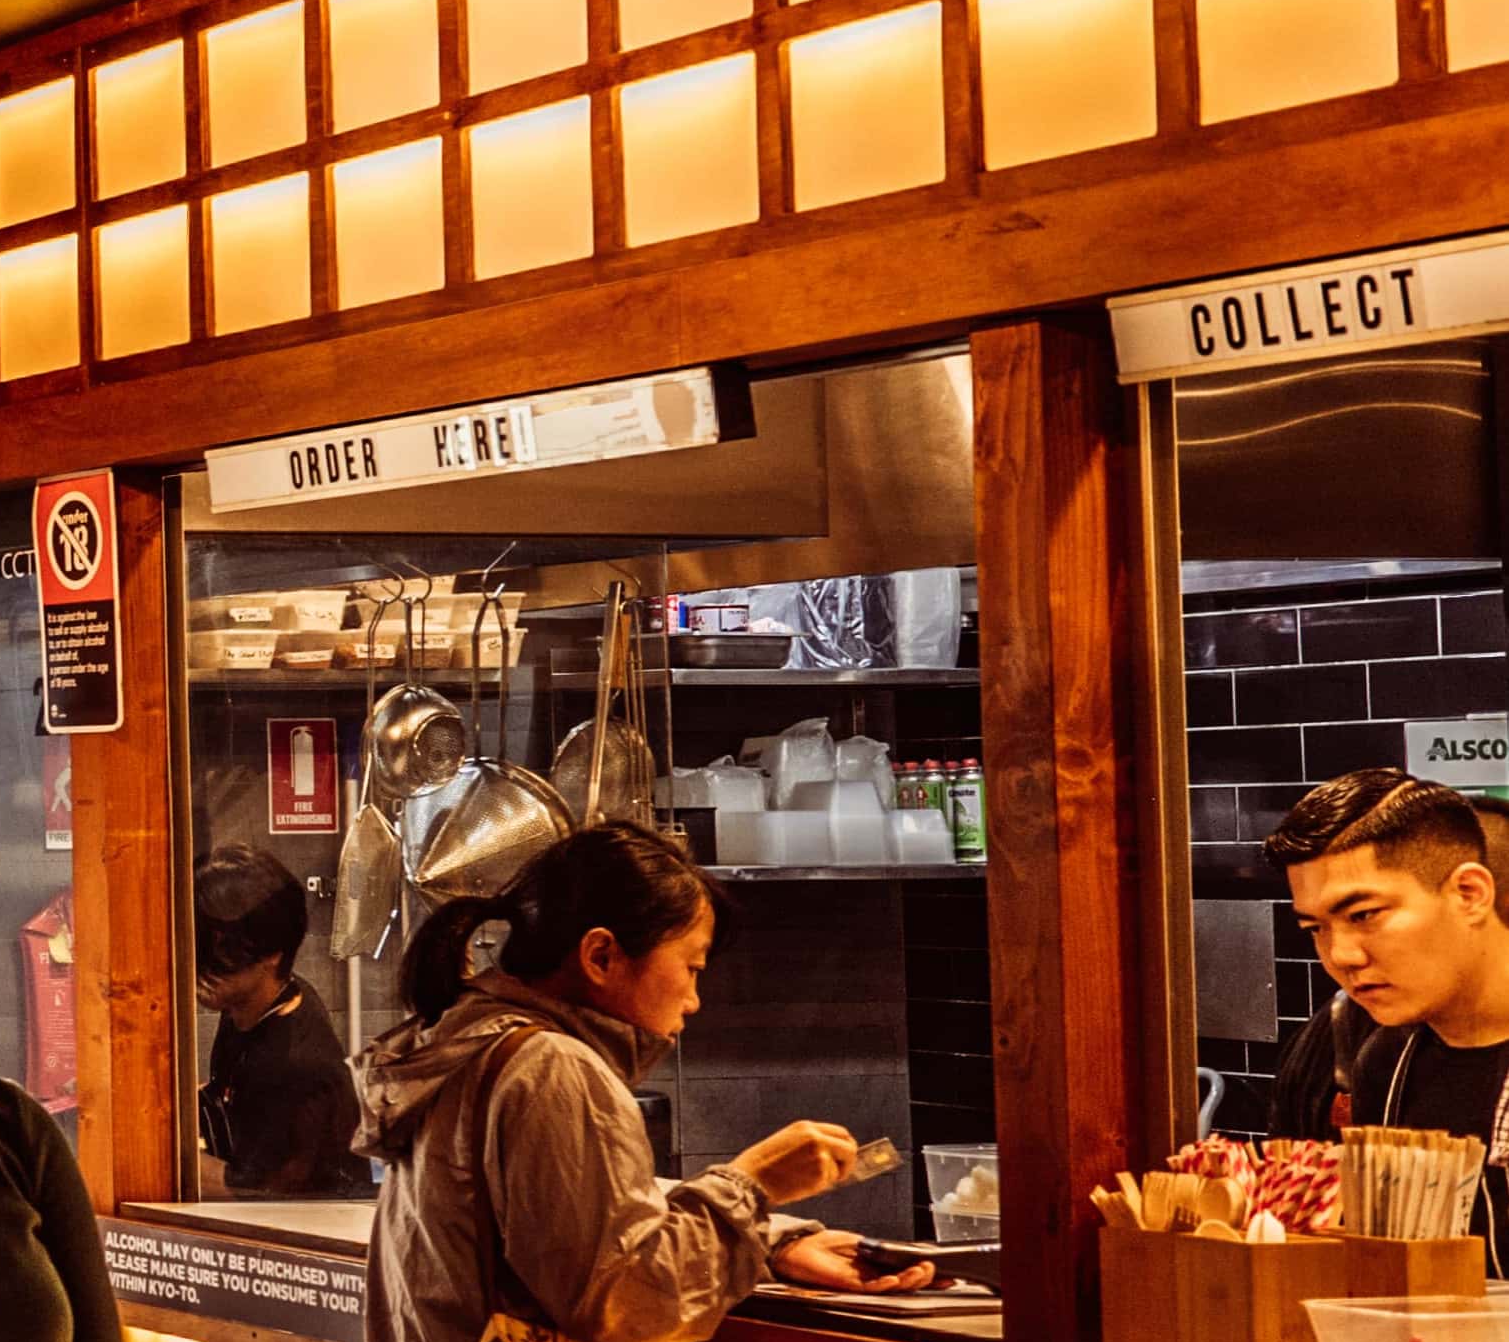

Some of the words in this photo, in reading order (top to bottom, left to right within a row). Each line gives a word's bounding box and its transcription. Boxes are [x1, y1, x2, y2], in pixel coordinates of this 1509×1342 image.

[1191, 267, 1415, 357] COLLECT
[289, 436, 379, 491] ORDER
[1, 550, 35, 579] CCT
[60, 525, 89, 572] 18
[105, 1231, 161, 1256] ALCOHOL
[162, 1241, 190, 1261] MAY
[191, 1246, 225, 1268] ONLY
[228, 1253, 246, 1272] BE
[248, 1256, 329, 1287] PURCHASED
[105, 1250, 149, 1273] PLEASE
[150, 1260, 186, 1281] MAKE
[187, 1267, 219, 1289] SURE
[221, 1274, 251, 1294] YOU
[252, 1280, 318, 1306] CONSUME
[320, 1291, 360, 1315] YOUR
[148, 1279, 201, 1305] KYO-TO.
